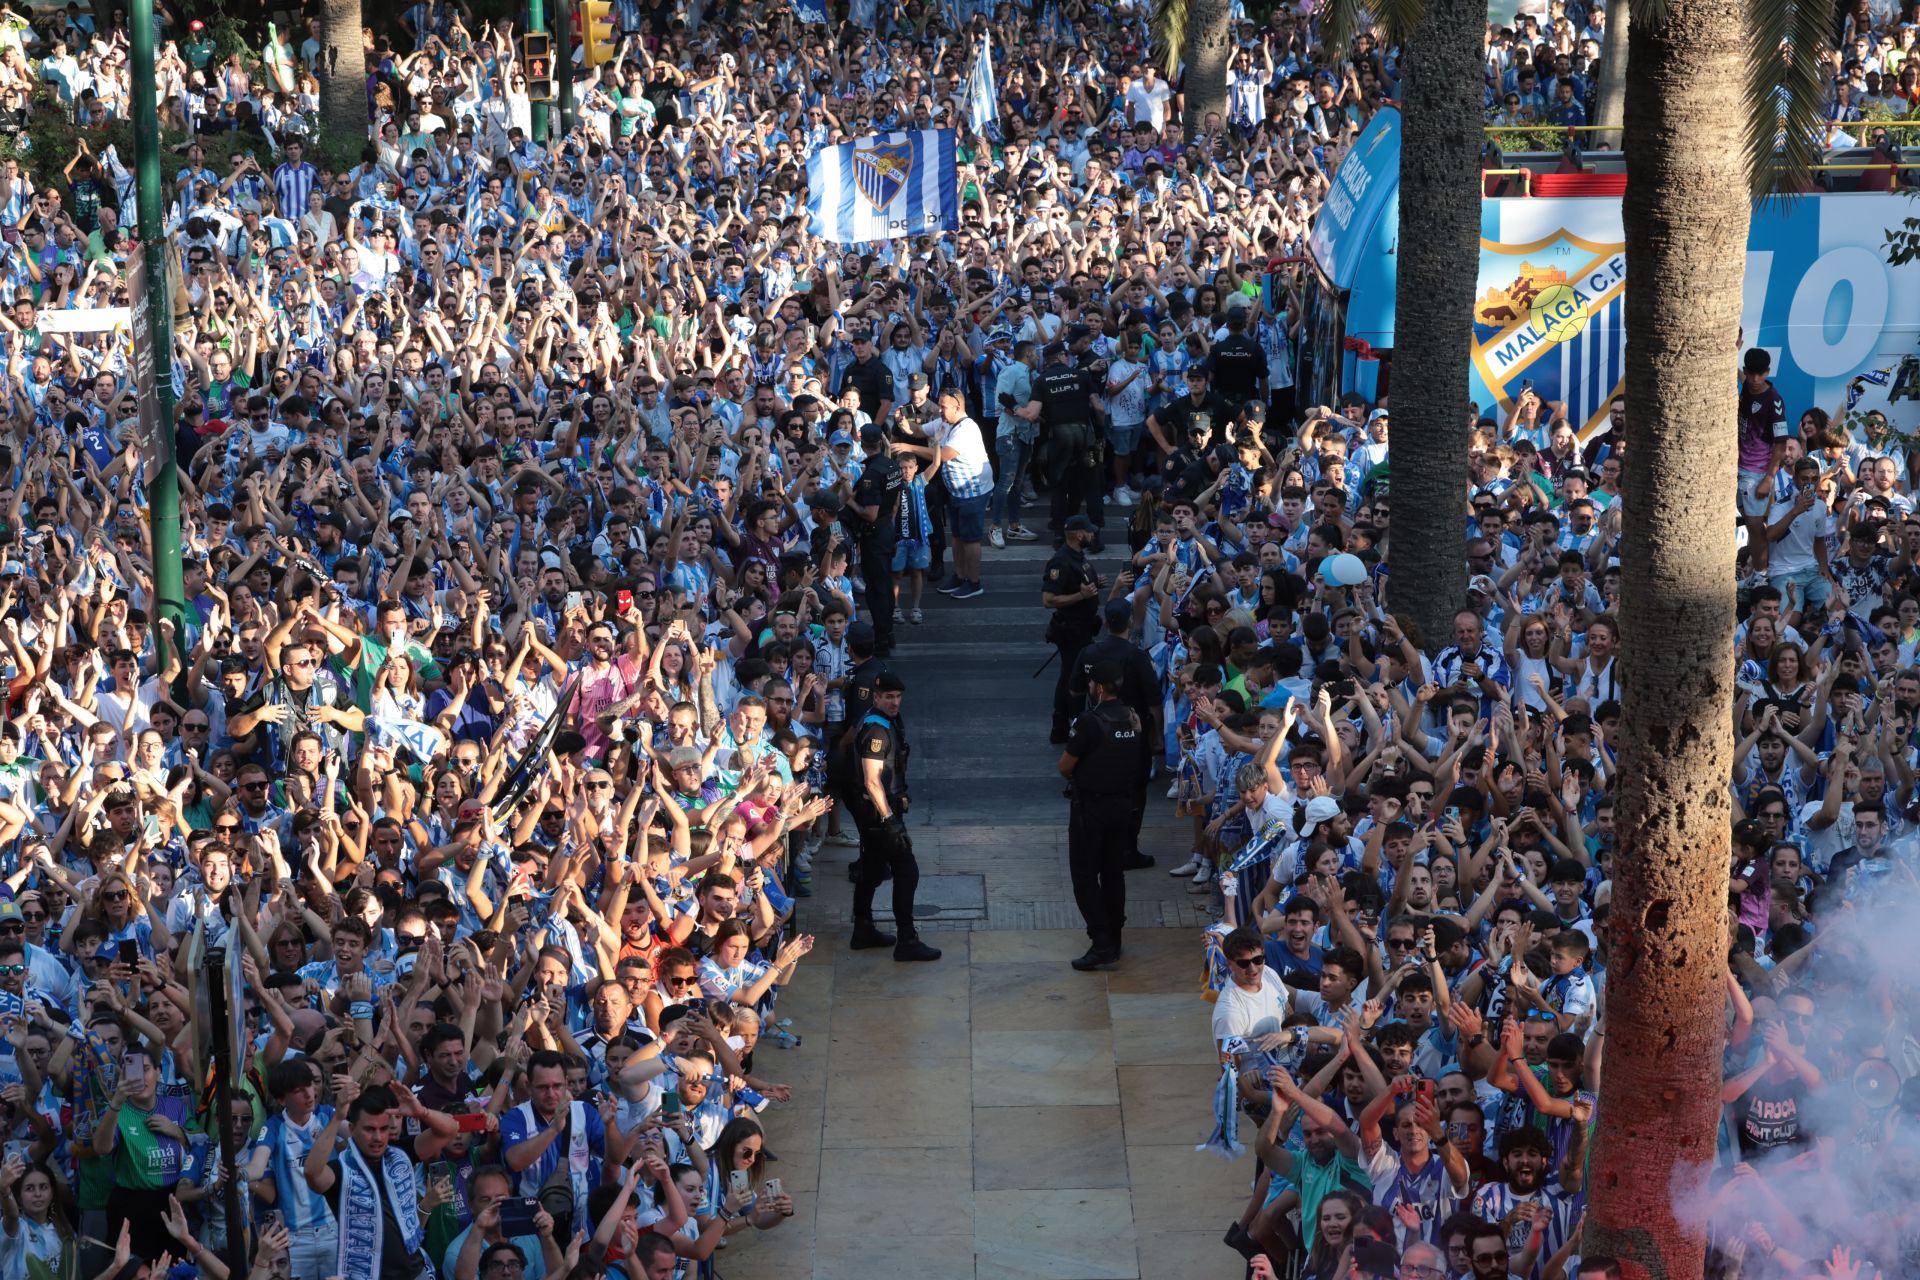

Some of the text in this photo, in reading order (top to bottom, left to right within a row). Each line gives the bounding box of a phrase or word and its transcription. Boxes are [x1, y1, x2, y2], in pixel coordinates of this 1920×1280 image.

[1341, 151, 1372, 203] GRACIAS
[1555, 247, 1571, 256] TM
[1494, 289, 1591, 367] MALAGA
[90, 435, 103, 450] 2
[1764, 1098, 1797, 1119] ROCA
